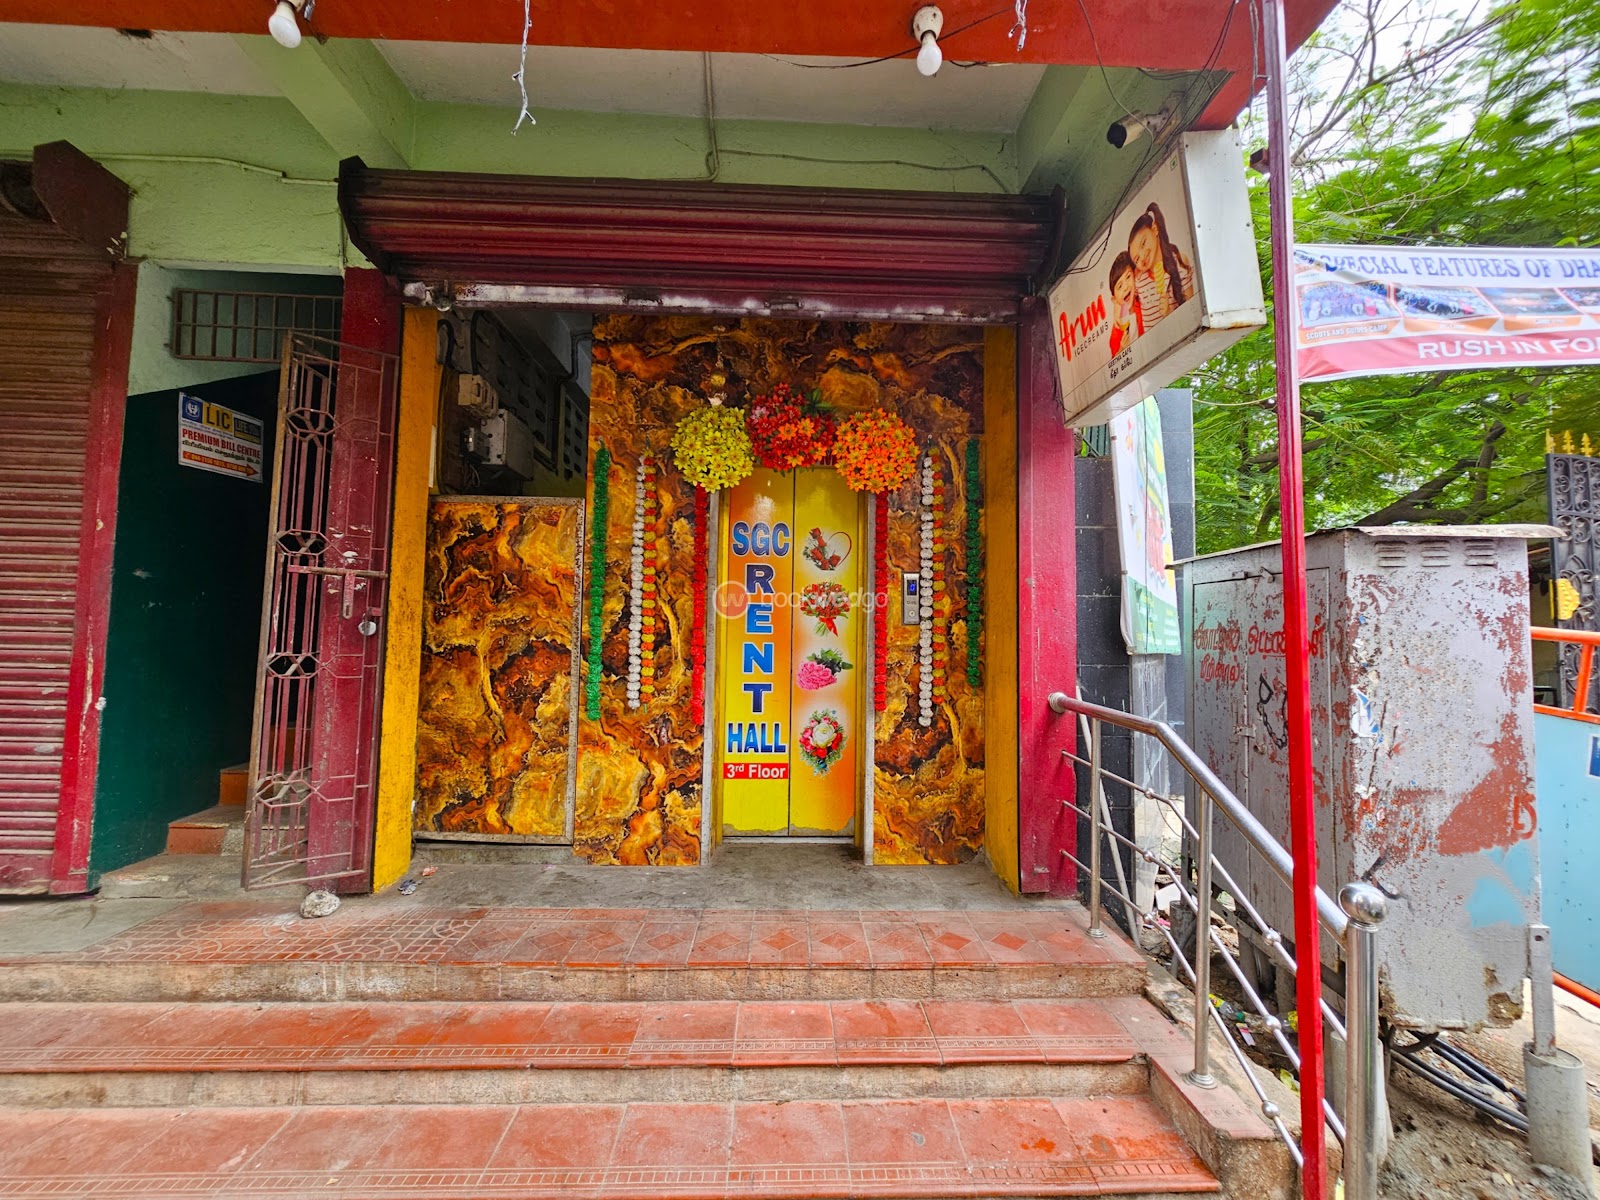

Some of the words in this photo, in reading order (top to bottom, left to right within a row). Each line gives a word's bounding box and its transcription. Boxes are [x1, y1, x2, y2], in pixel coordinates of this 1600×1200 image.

[1411, 256, 1520, 277] FEATURES
[1524, 258, 1552, 278] OF
[1059, 294, 1106, 362] Arun
[1074, 321, 1109, 357] ICECREAMS
[1306, 330, 1330, 340] SCOUTS
[1332, 328, 1345, 337] AND
[1369, 324, 1387, 333] CAMP
[1122, 346, 1132, 358] CAFE
[1418, 340, 1506, 359] RUSH
[1511, 339, 1547, 355] IN
[206, 405, 231, 430] LIC
[182, 428, 219, 447] PREMIUM
[221, 439, 236, 452] BILL
[237, 444, 261, 459] CENTRE
[732, 521, 790, 557] SGC
[743, 563, 775, 714] RENT
[727, 722, 787, 754] HALL
[727, 763, 745, 779] 3rd
[748, 764, 787, 779] Floor
